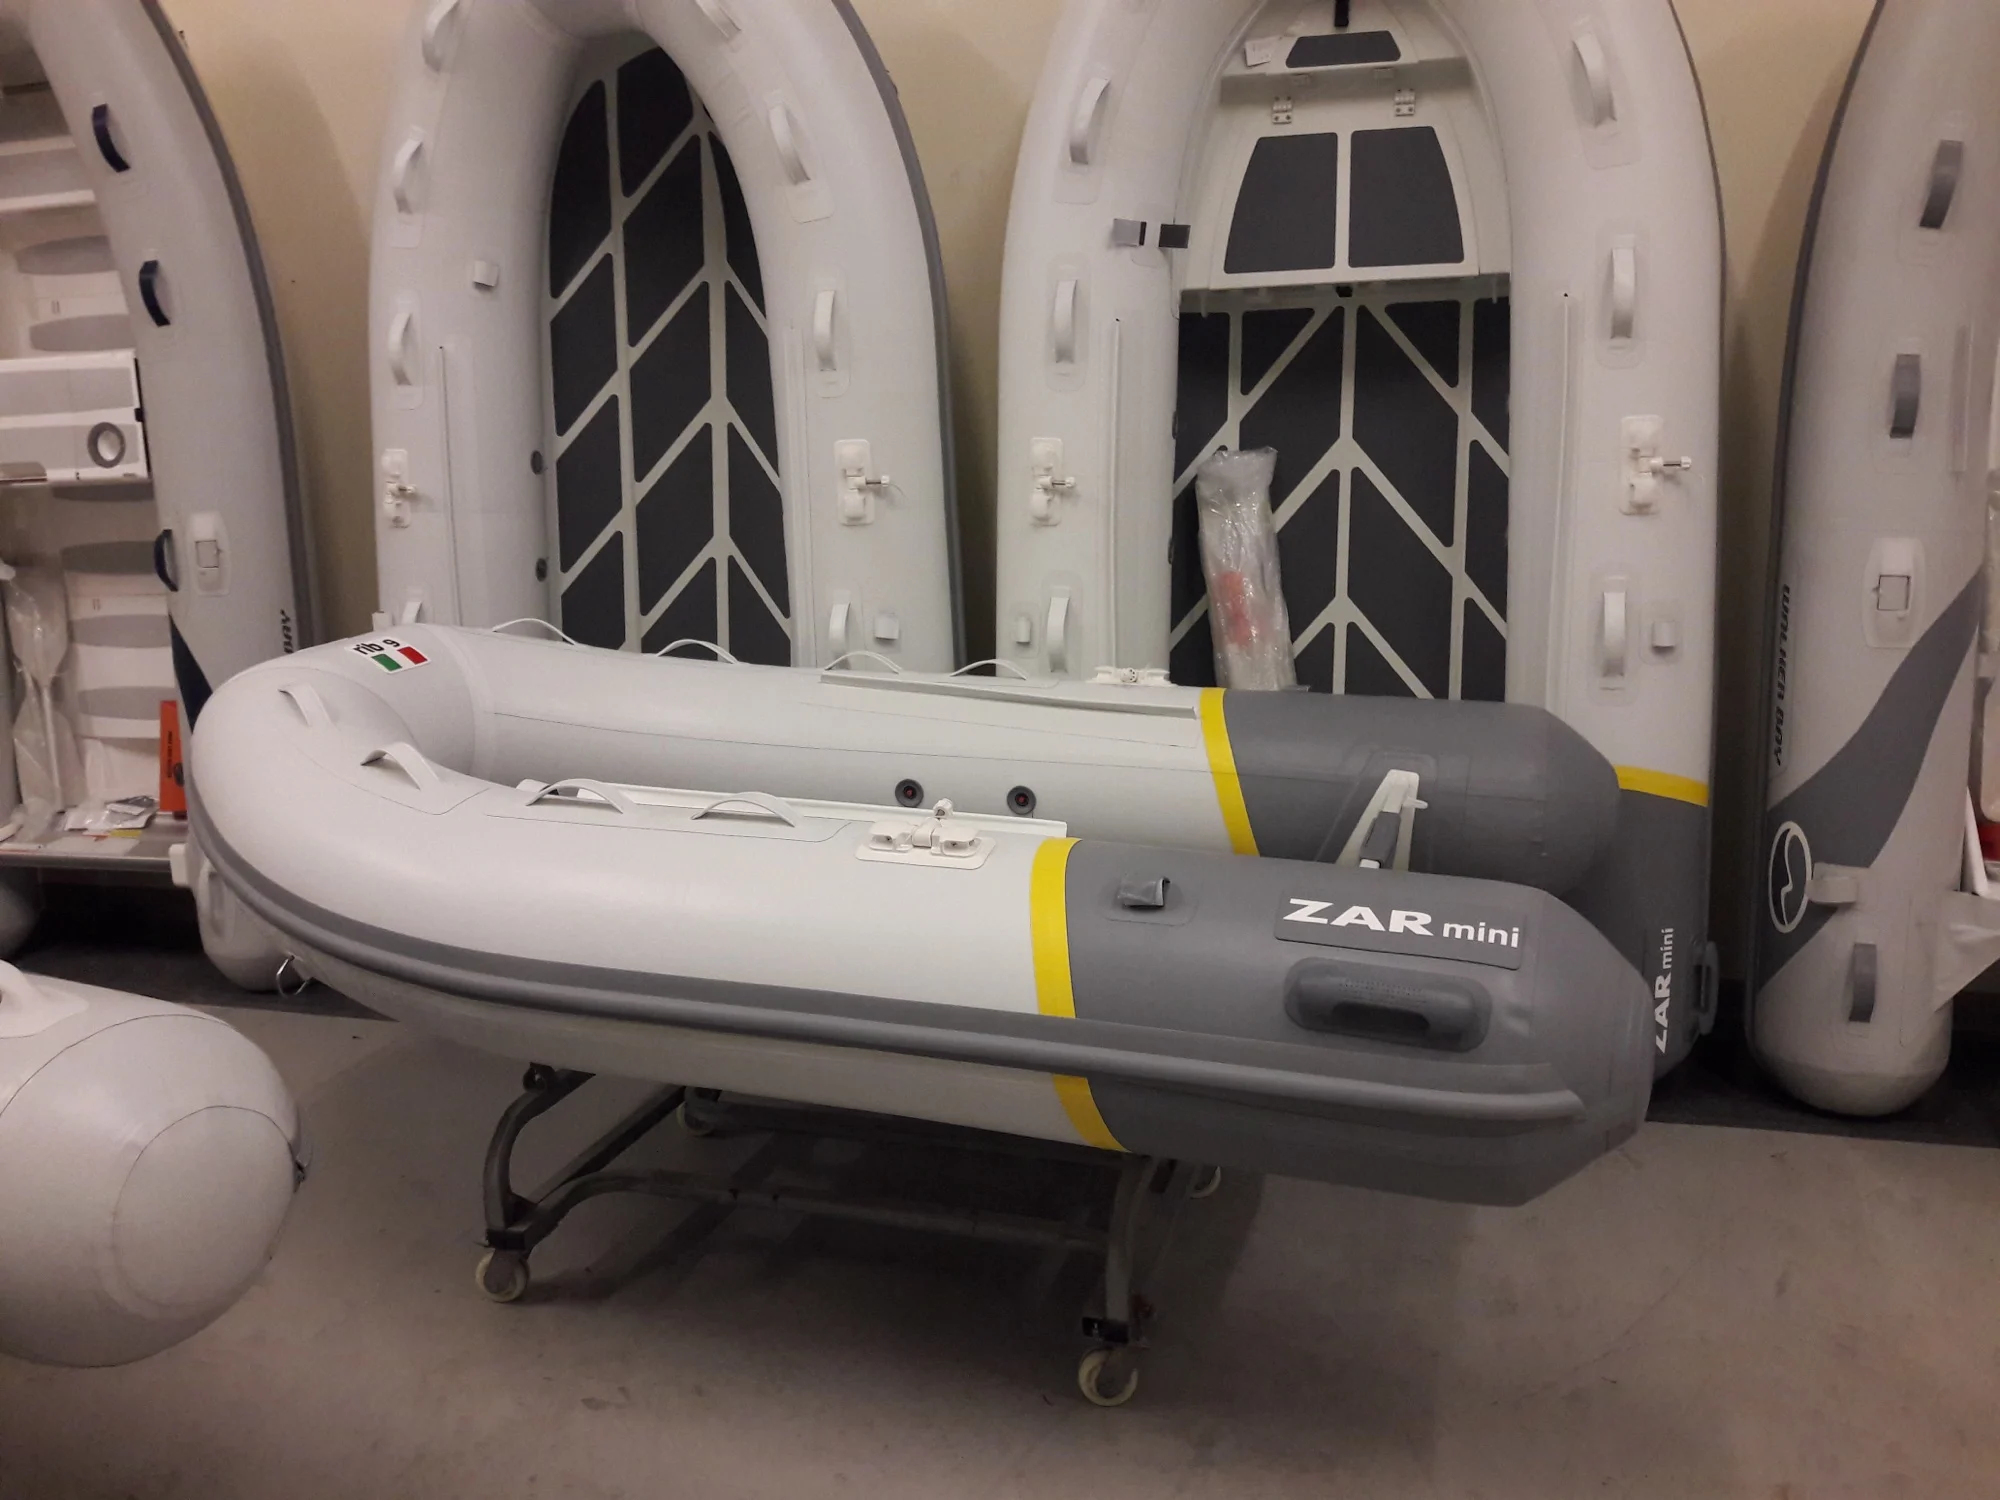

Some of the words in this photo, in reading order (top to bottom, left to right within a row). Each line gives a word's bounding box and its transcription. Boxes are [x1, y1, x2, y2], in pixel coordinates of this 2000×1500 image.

[353, 642, 385, 656] rib
[1283, 898, 1434, 936] ZAR
[1443, 922, 1519, 948] mini
[1660, 927, 1674, 969] mini
